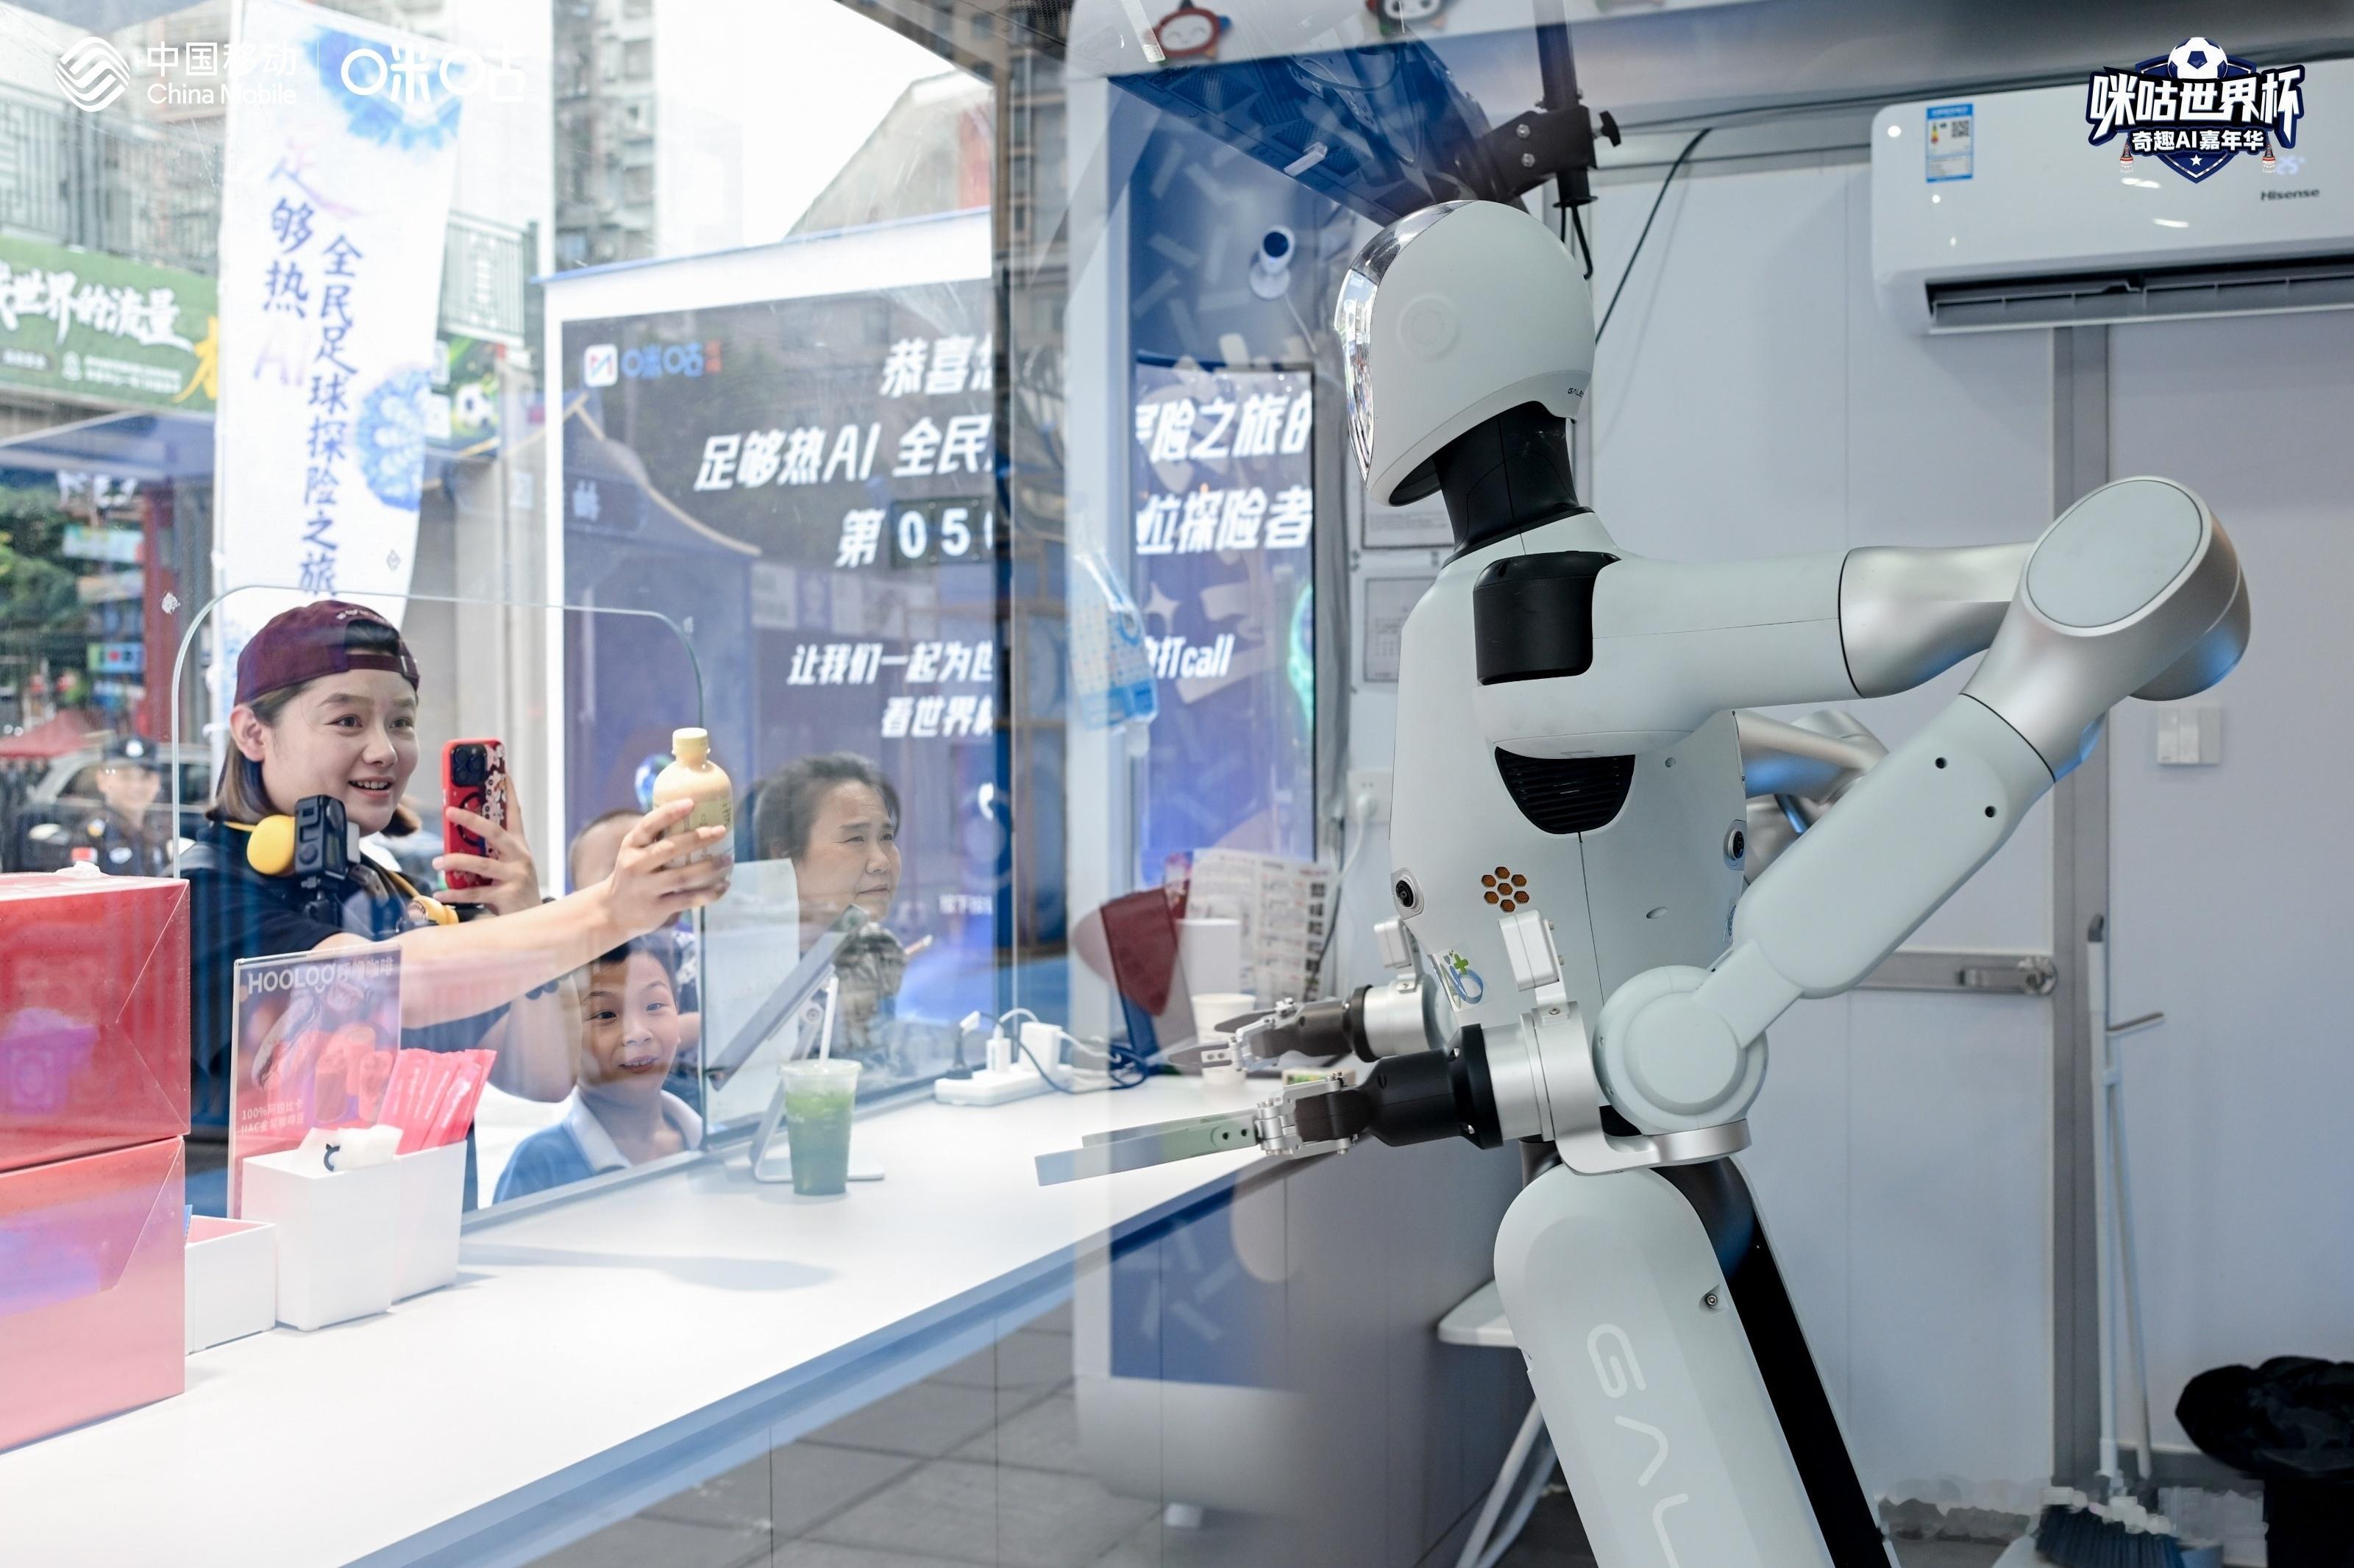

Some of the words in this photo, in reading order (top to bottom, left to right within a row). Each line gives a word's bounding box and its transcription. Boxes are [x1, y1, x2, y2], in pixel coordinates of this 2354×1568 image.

[2260, 189, 2320, 202] Hisense
[694, 421, 881, 491] 足够热AI
[892, 413, 992, 478] 全民
[835, 508, 887, 569] 第
[898, 507, 992, 560] 05
[248, 964, 335, 994] HOOLOO
